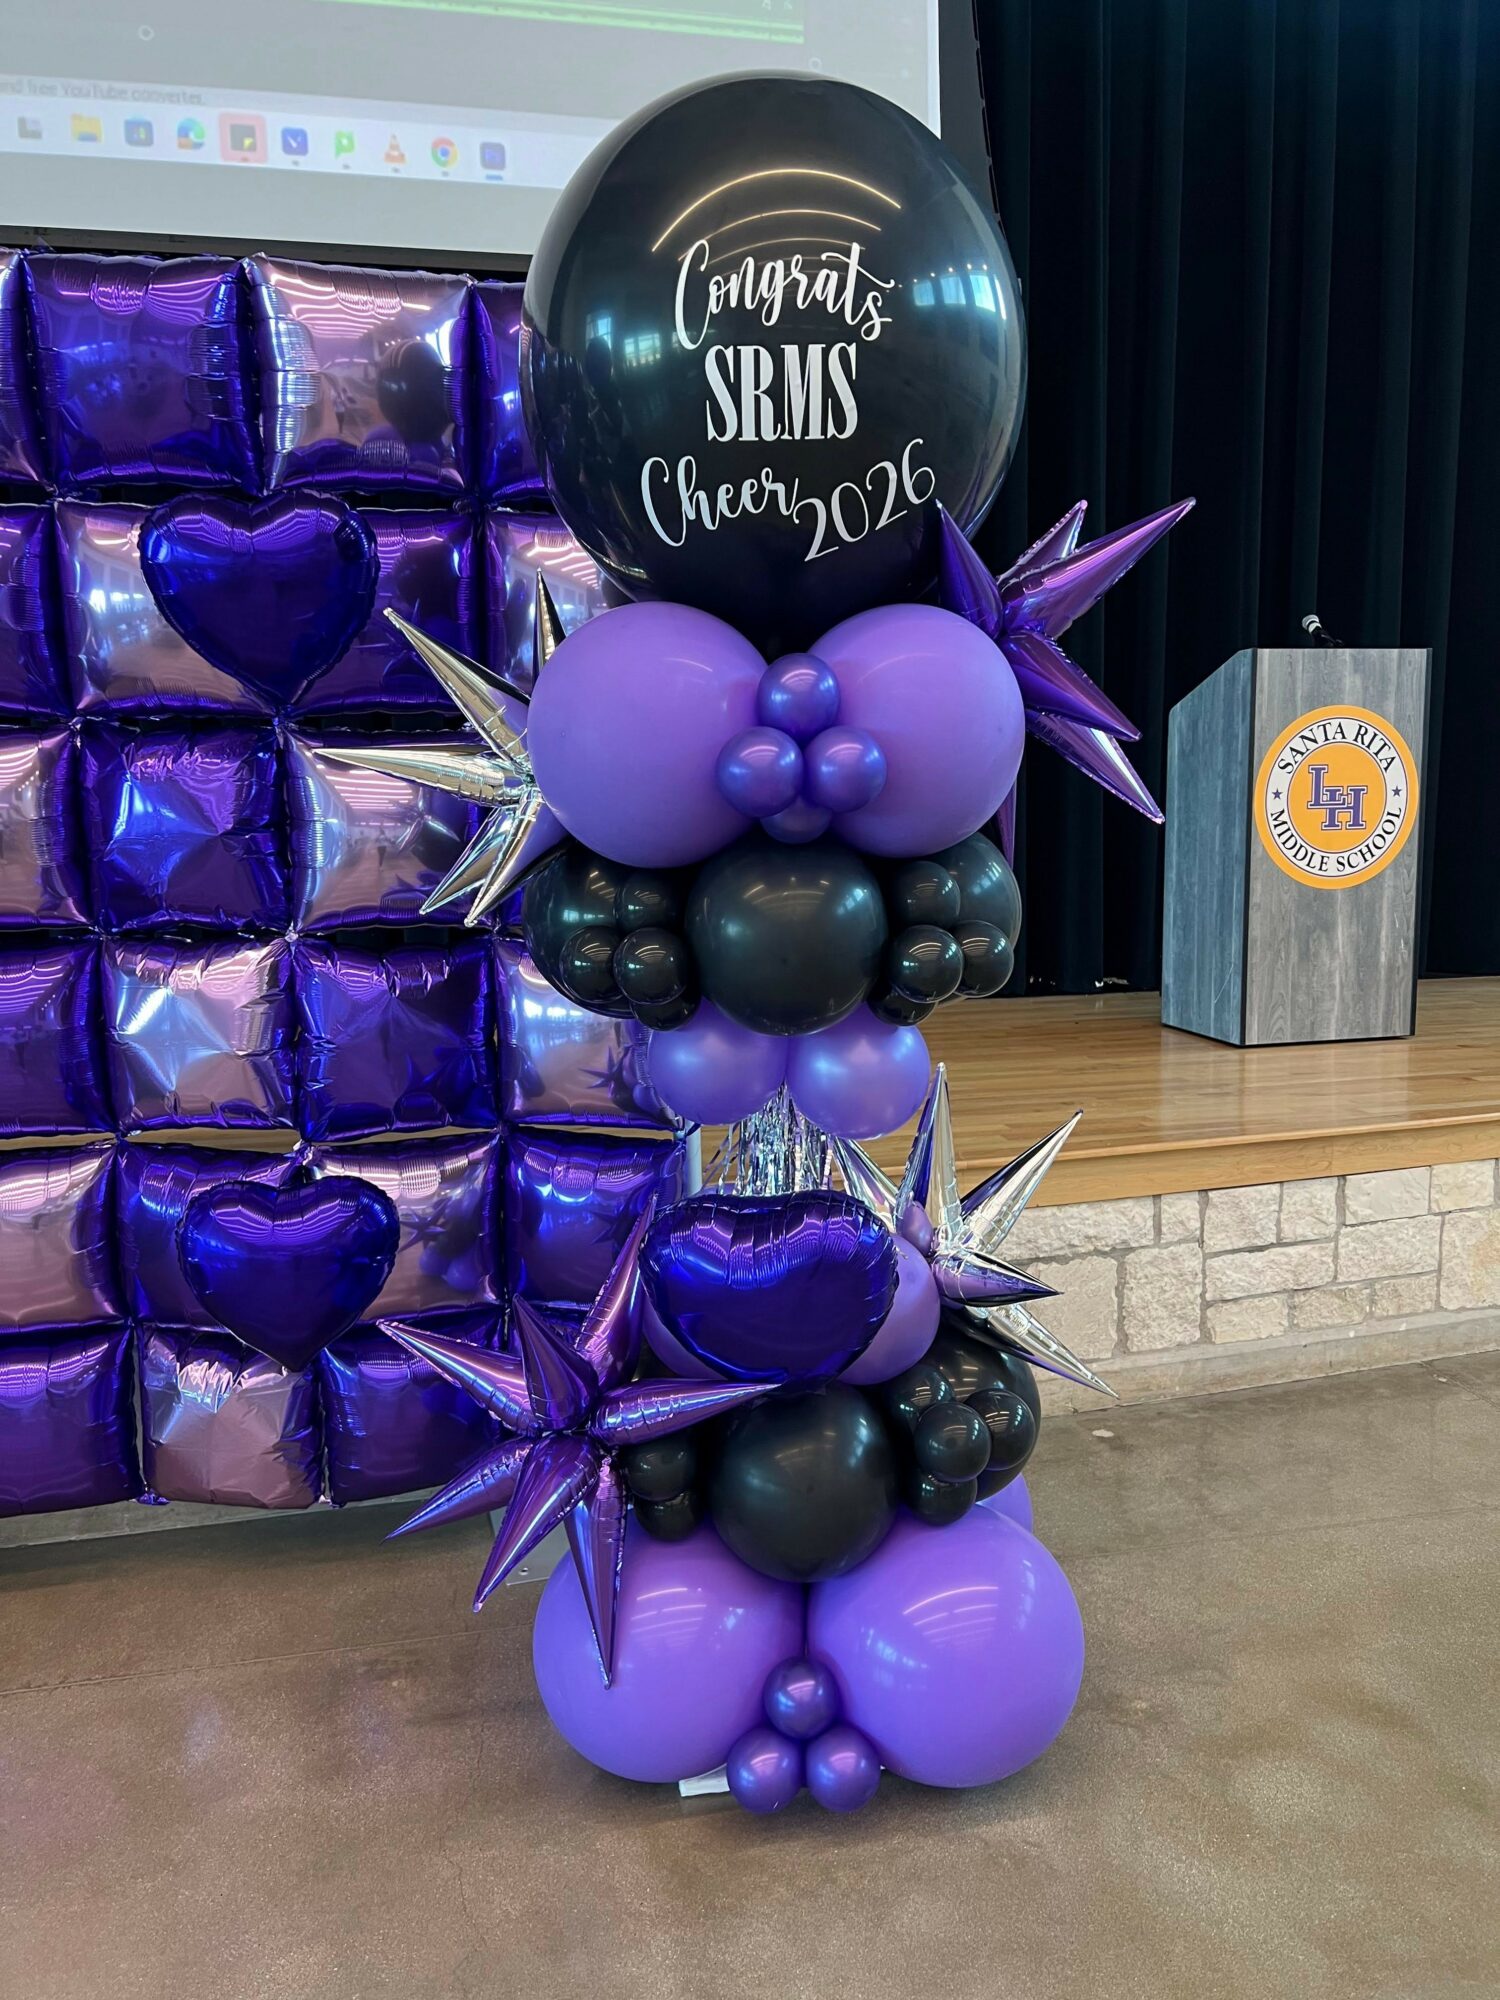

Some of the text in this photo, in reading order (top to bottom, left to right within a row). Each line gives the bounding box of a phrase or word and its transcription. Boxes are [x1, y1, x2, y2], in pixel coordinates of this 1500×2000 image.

[62, 81, 128, 99] YouTube
[675, 239, 895, 349] Congrats
[705, 342, 858, 442] SRMS
[641, 438, 936, 562] Cheer 2026
[1277, 721, 1397, 774] SANTA RITA
[1270, 807, 1402, 873] MIDDLE SCHOOL
